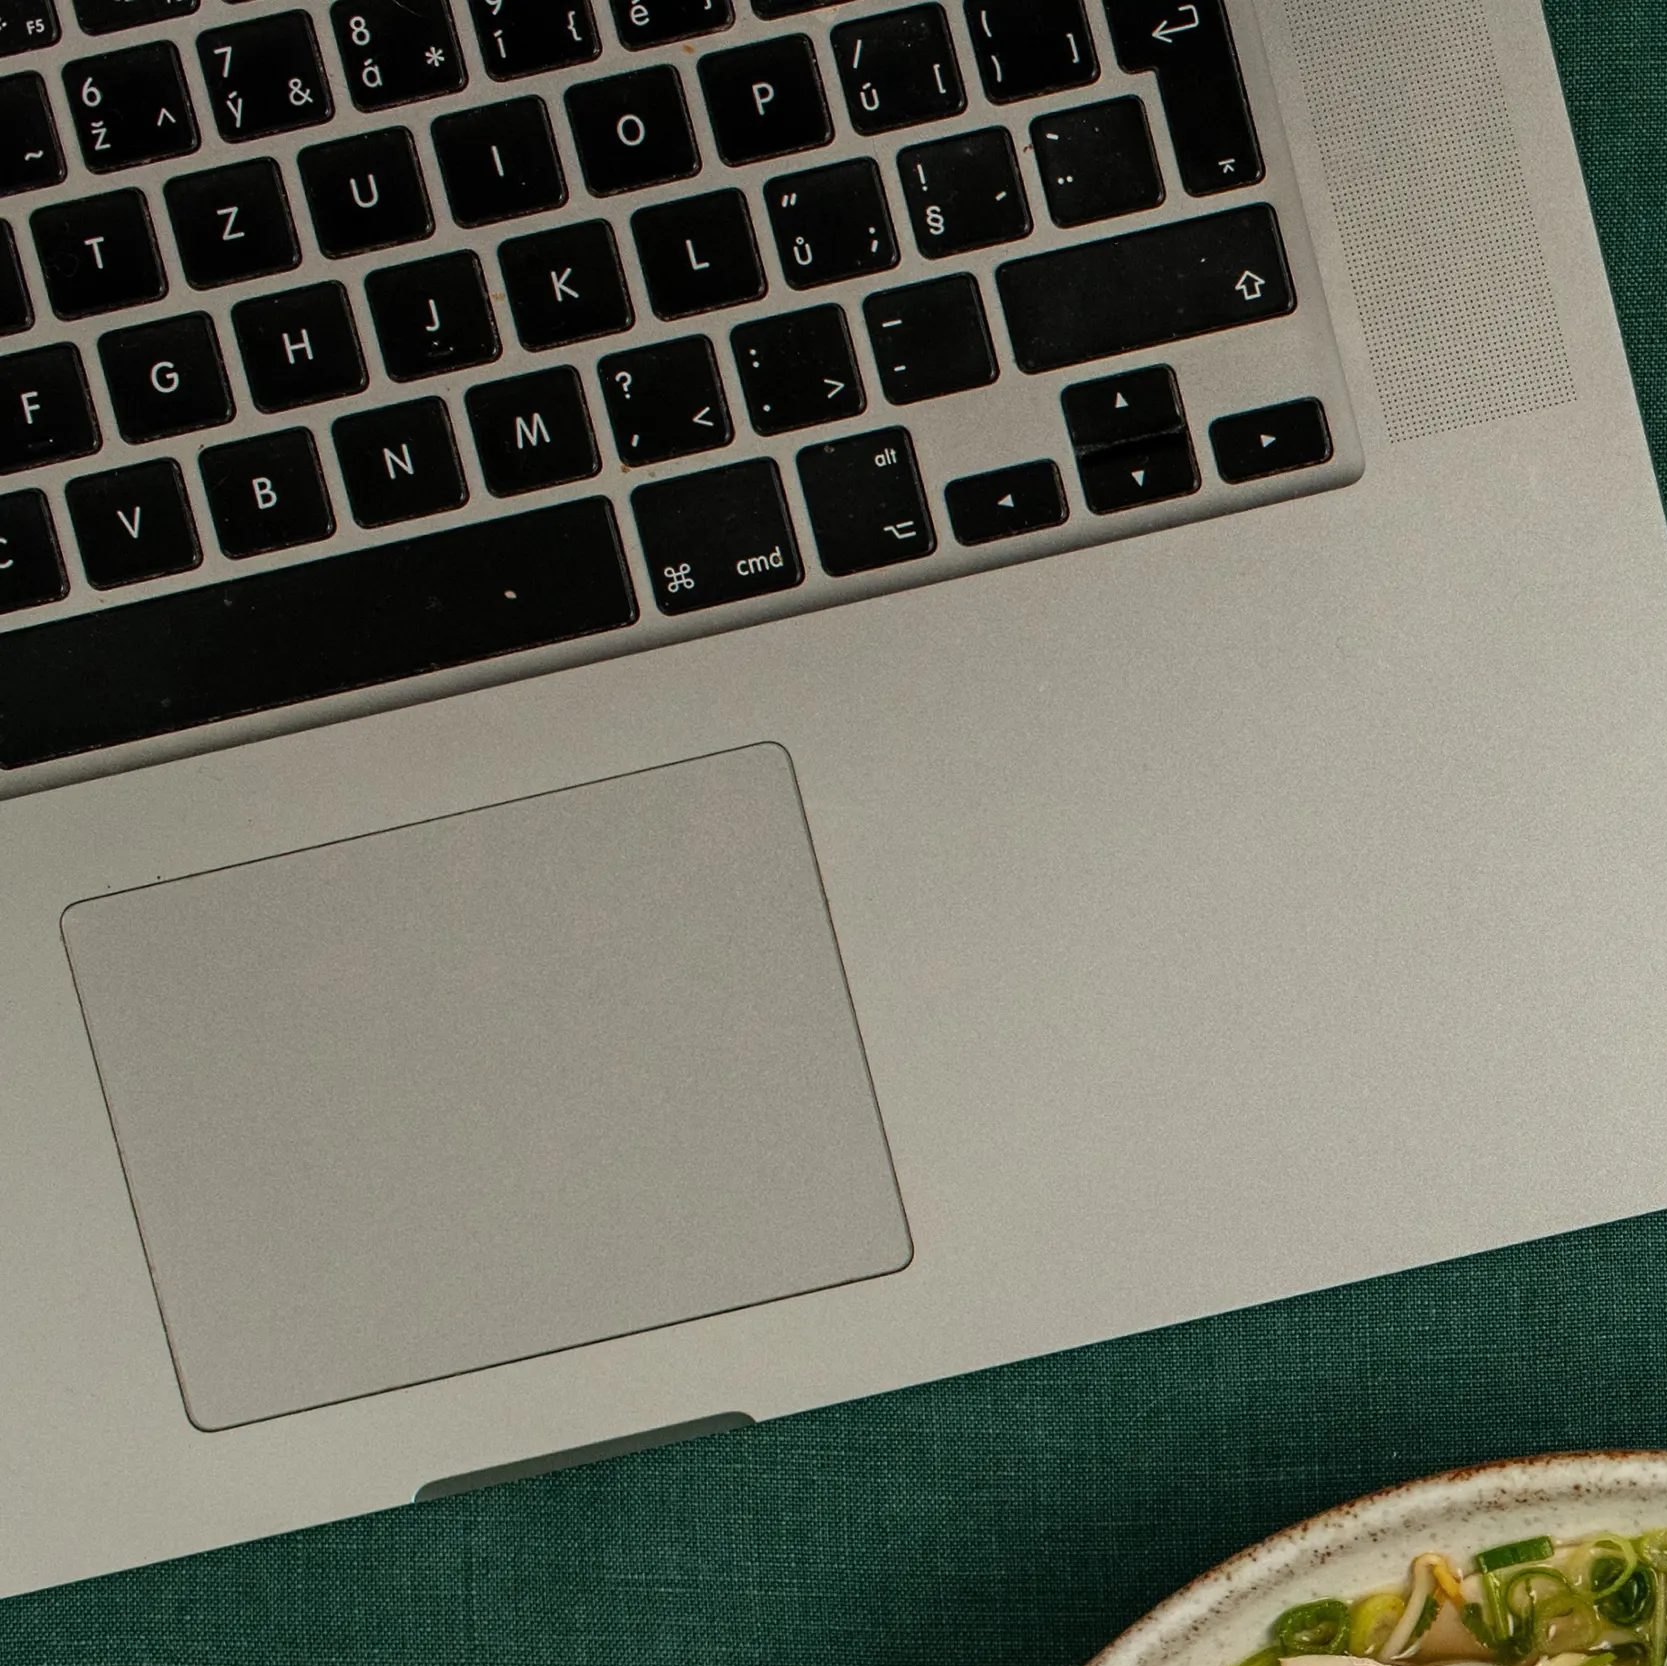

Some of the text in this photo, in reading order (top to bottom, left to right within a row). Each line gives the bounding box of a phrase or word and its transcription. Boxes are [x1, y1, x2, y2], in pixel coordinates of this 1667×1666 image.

[26, 18, 45, 35] F5
[349, 15, 371, 46] 8
[213, 46, 233, 78] 7
[362, 58, 383, 88] á
[82, 77, 102, 107] 6
[288, 78, 314, 106] &
[752, 82, 774, 116] P
[616, 114, 645, 146] O
[349, 174, 379, 208] U
[216, 206, 245, 241] Z
[84, 236, 105, 270] T
[685, 239, 710, 270] L
[550, 267, 580, 302] K
[425, 298, 440, 332] J
[282, 328, 314, 365] H
[150, 361, 180, 393] G
[20, 391, 41, 425] F
[515, 412, 551, 449] M
[383, 443, 414, 480] N
[874, 448, 897, 468] alt
[252, 477, 278, 510] B
[116, 506, 141, 539] V
[736, 545, 784, 577] cmd
